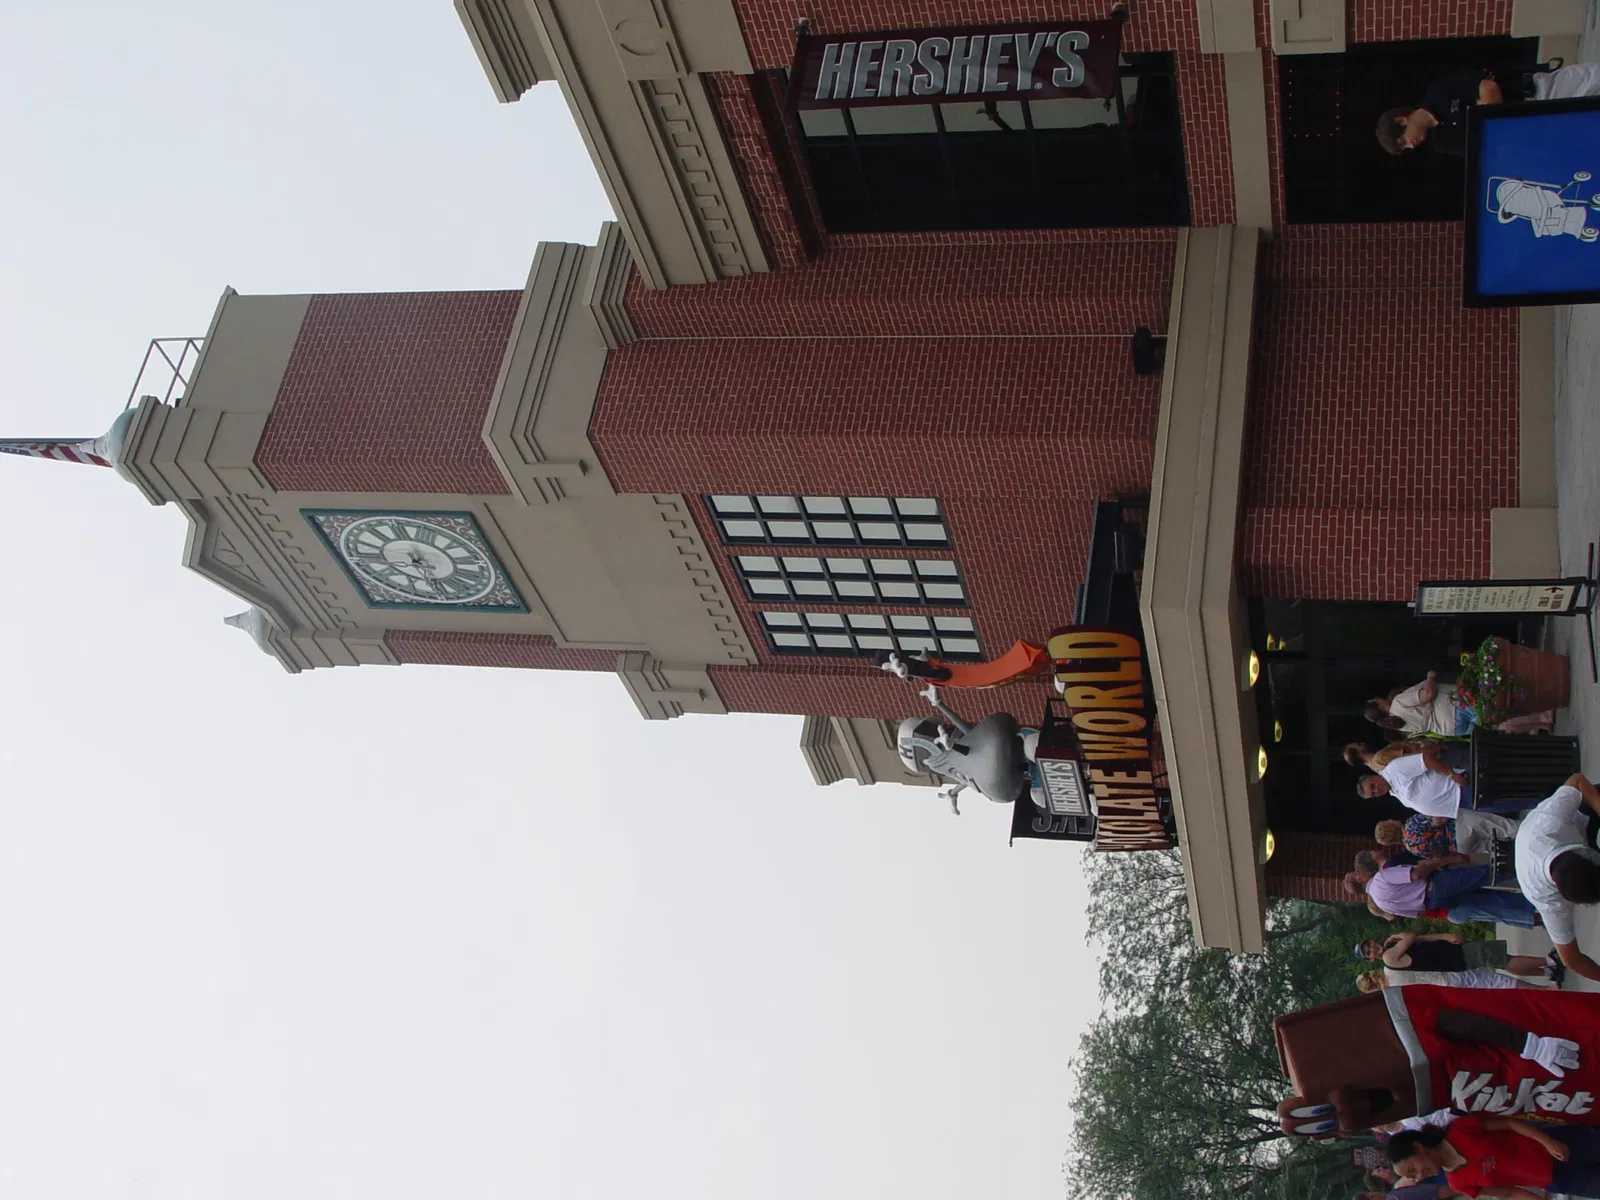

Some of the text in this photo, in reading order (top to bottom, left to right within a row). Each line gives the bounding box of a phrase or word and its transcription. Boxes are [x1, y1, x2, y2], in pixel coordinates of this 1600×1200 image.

[815, 30, 1090, 100] HERSHEY'S
[1048, 632, 1149, 760] WORLD
[1042, 762, 1084, 813] HERSHEY'S
[1451, 1070, 1595, 1116] KitKat
